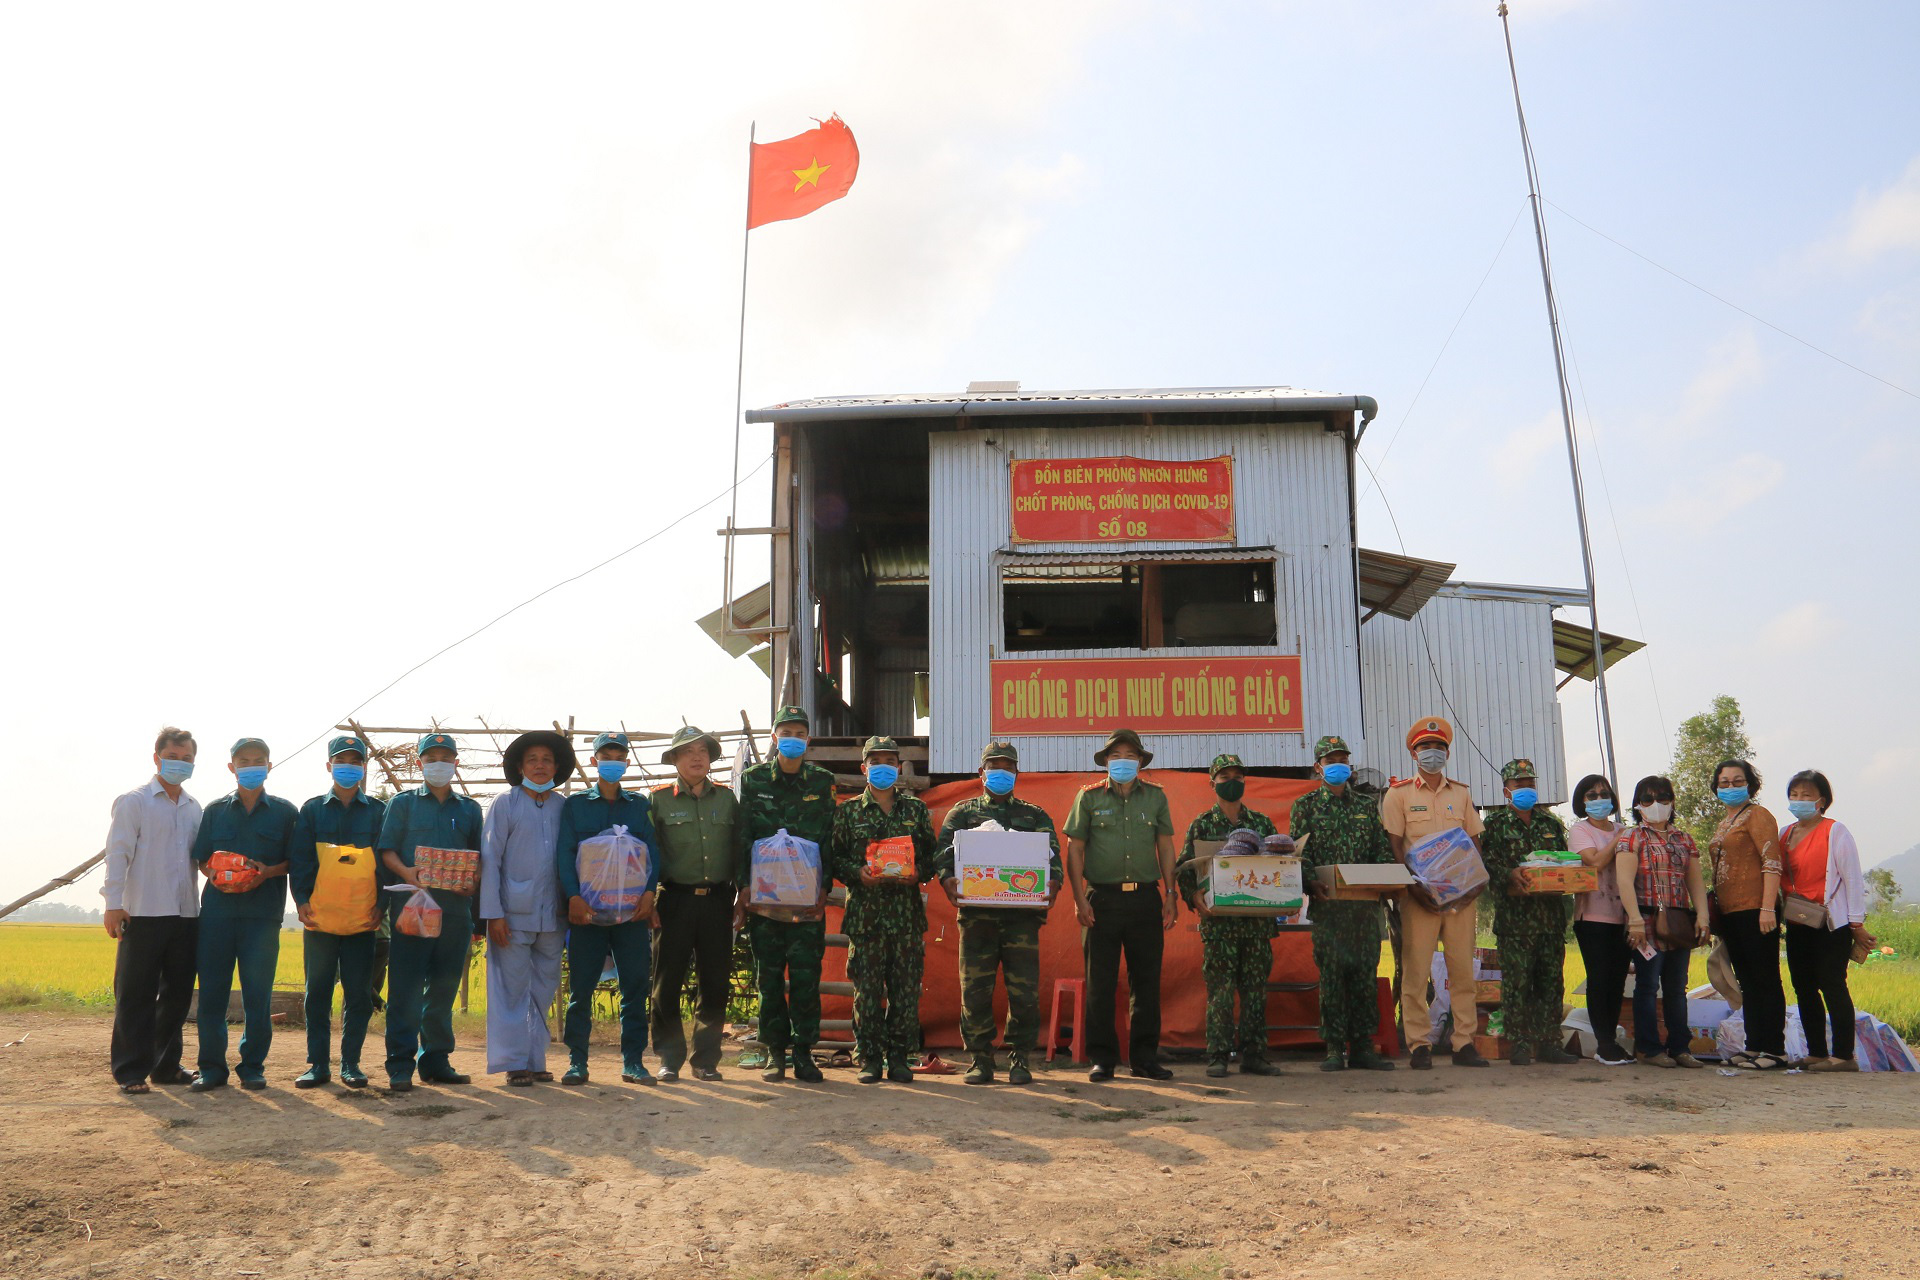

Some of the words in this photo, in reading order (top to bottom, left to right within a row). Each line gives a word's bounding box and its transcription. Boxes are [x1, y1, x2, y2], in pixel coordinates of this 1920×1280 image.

[1035, 463, 1060, 485] ĐỒN
[1064, 465, 1093, 484] BIÊN
[1096, 464, 1136, 483] PHÒNG
[1139, 466, 1171, 483] NHƠN
[1175, 466, 1208, 483] HƯNG
[1016, 490, 1047, 512] CHỐT
[1051, 492, 1095, 513] PHÒNG,
[1099, 488, 1138, 511] CHỐNG
[1142, 494, 1170, 512] DỊCH
[1174, 494, 1228, 511] COVID-19
[1098, 515, 1122, 537] SỐ
[1126, 521, 1148, 537] 08
[1003, 668, 1068, 719] CHỐNG
[1075, 678, 1119, 725] DỊCH
[1126, 672, 1165, 717] NHƯ
[1172, 665, 1237, 717] CHỐNG
[1244, 669, 1290, 723] GIẶC
